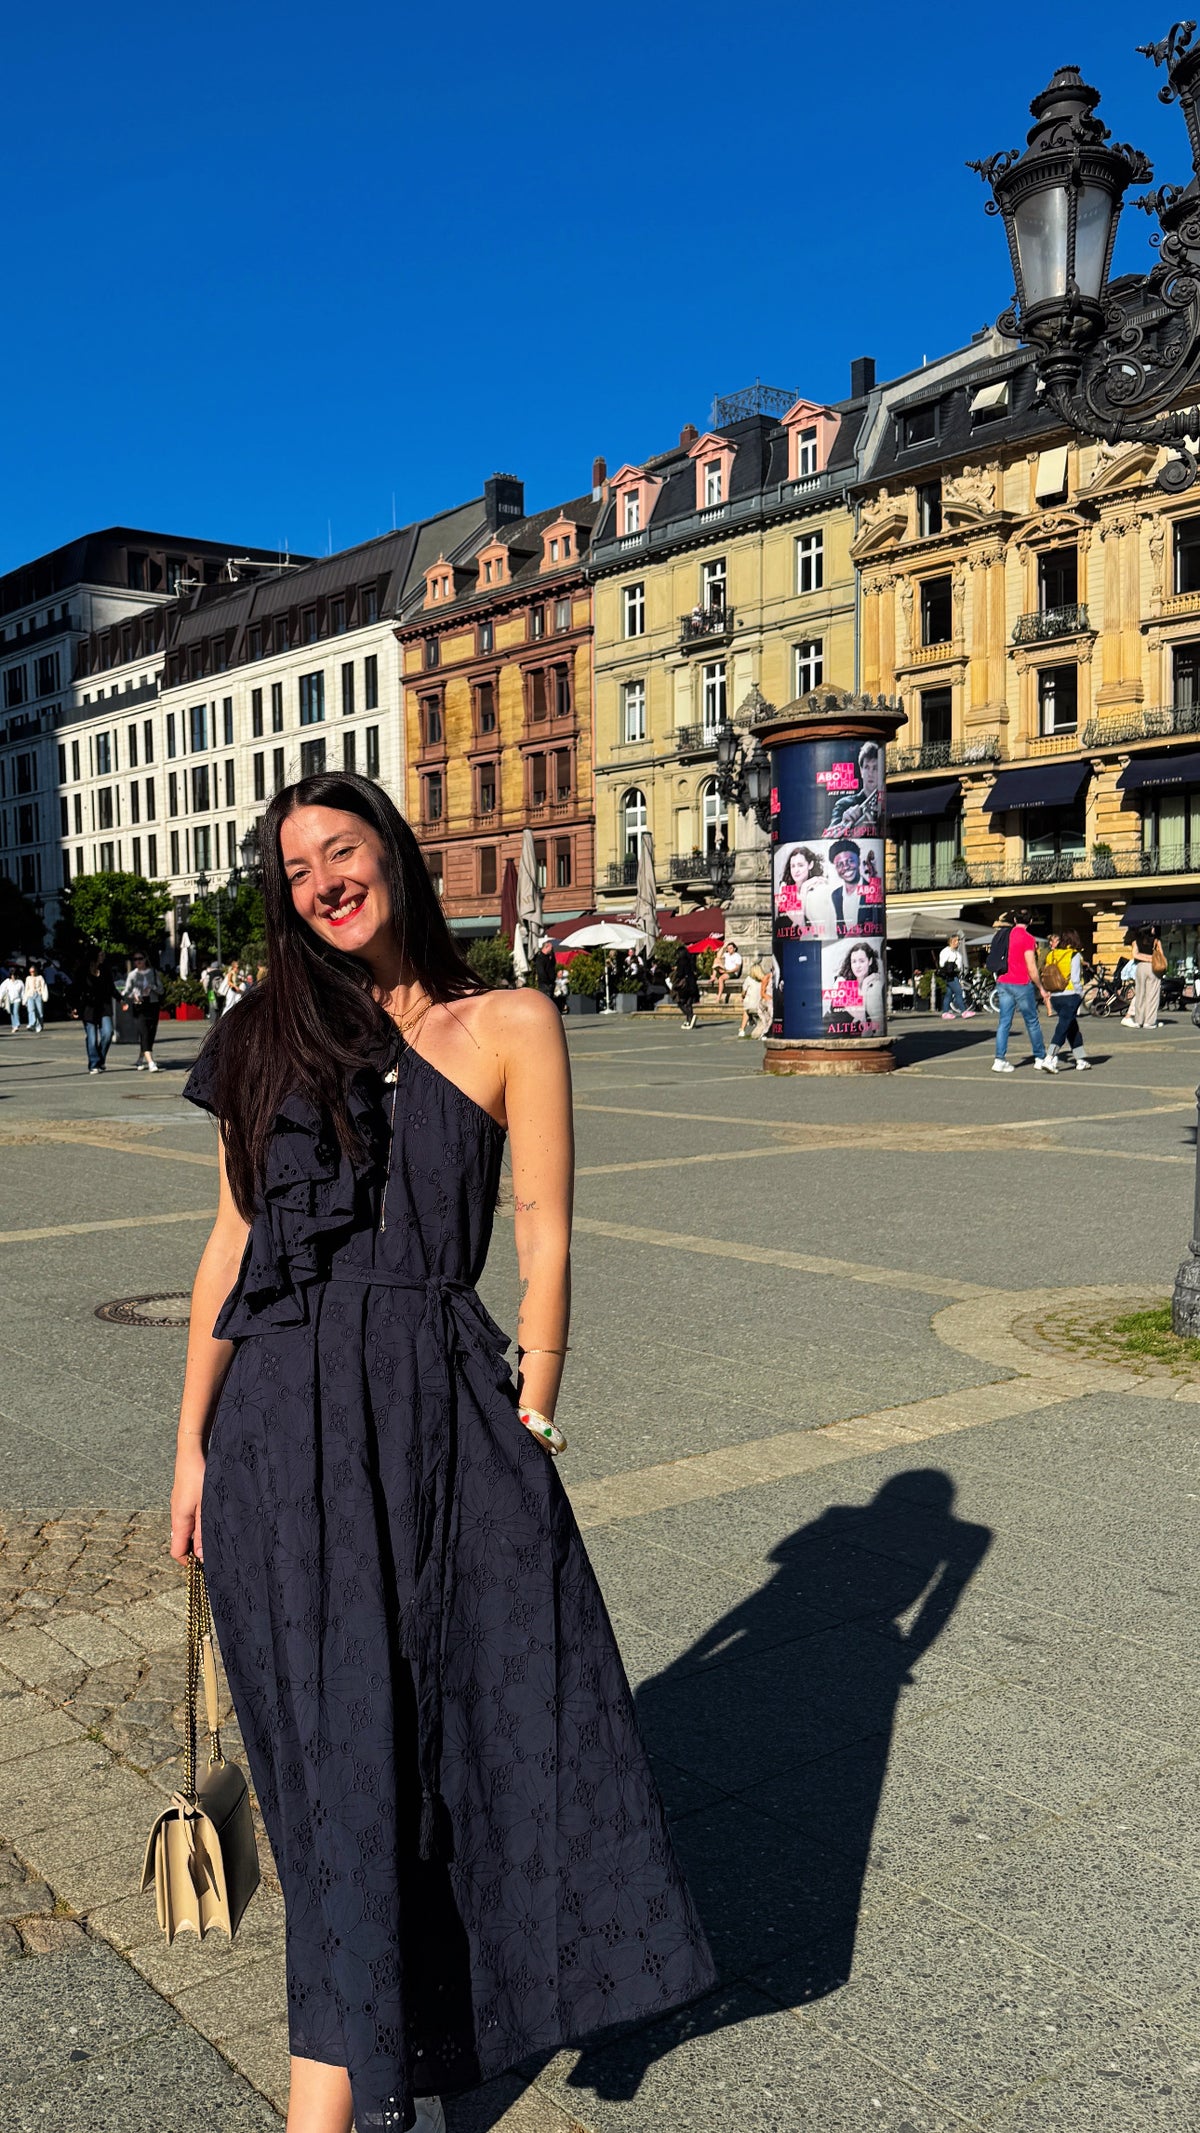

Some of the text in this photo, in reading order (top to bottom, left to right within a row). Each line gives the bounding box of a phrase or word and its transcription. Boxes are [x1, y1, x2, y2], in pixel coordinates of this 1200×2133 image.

[834, 764, 854, 772] ALL
[818, 771, 854, 781] ABOUT
[827, 780, 858, 789] MUSIC
[776, 926, 797, 938] ALTE
[839, 981, 858, 989] ALL
[823, 989, 858, 999] ABOUT
[833, 998, 863, 1006] MUSIC
[827, 1023, 858, 1034] ALTE
